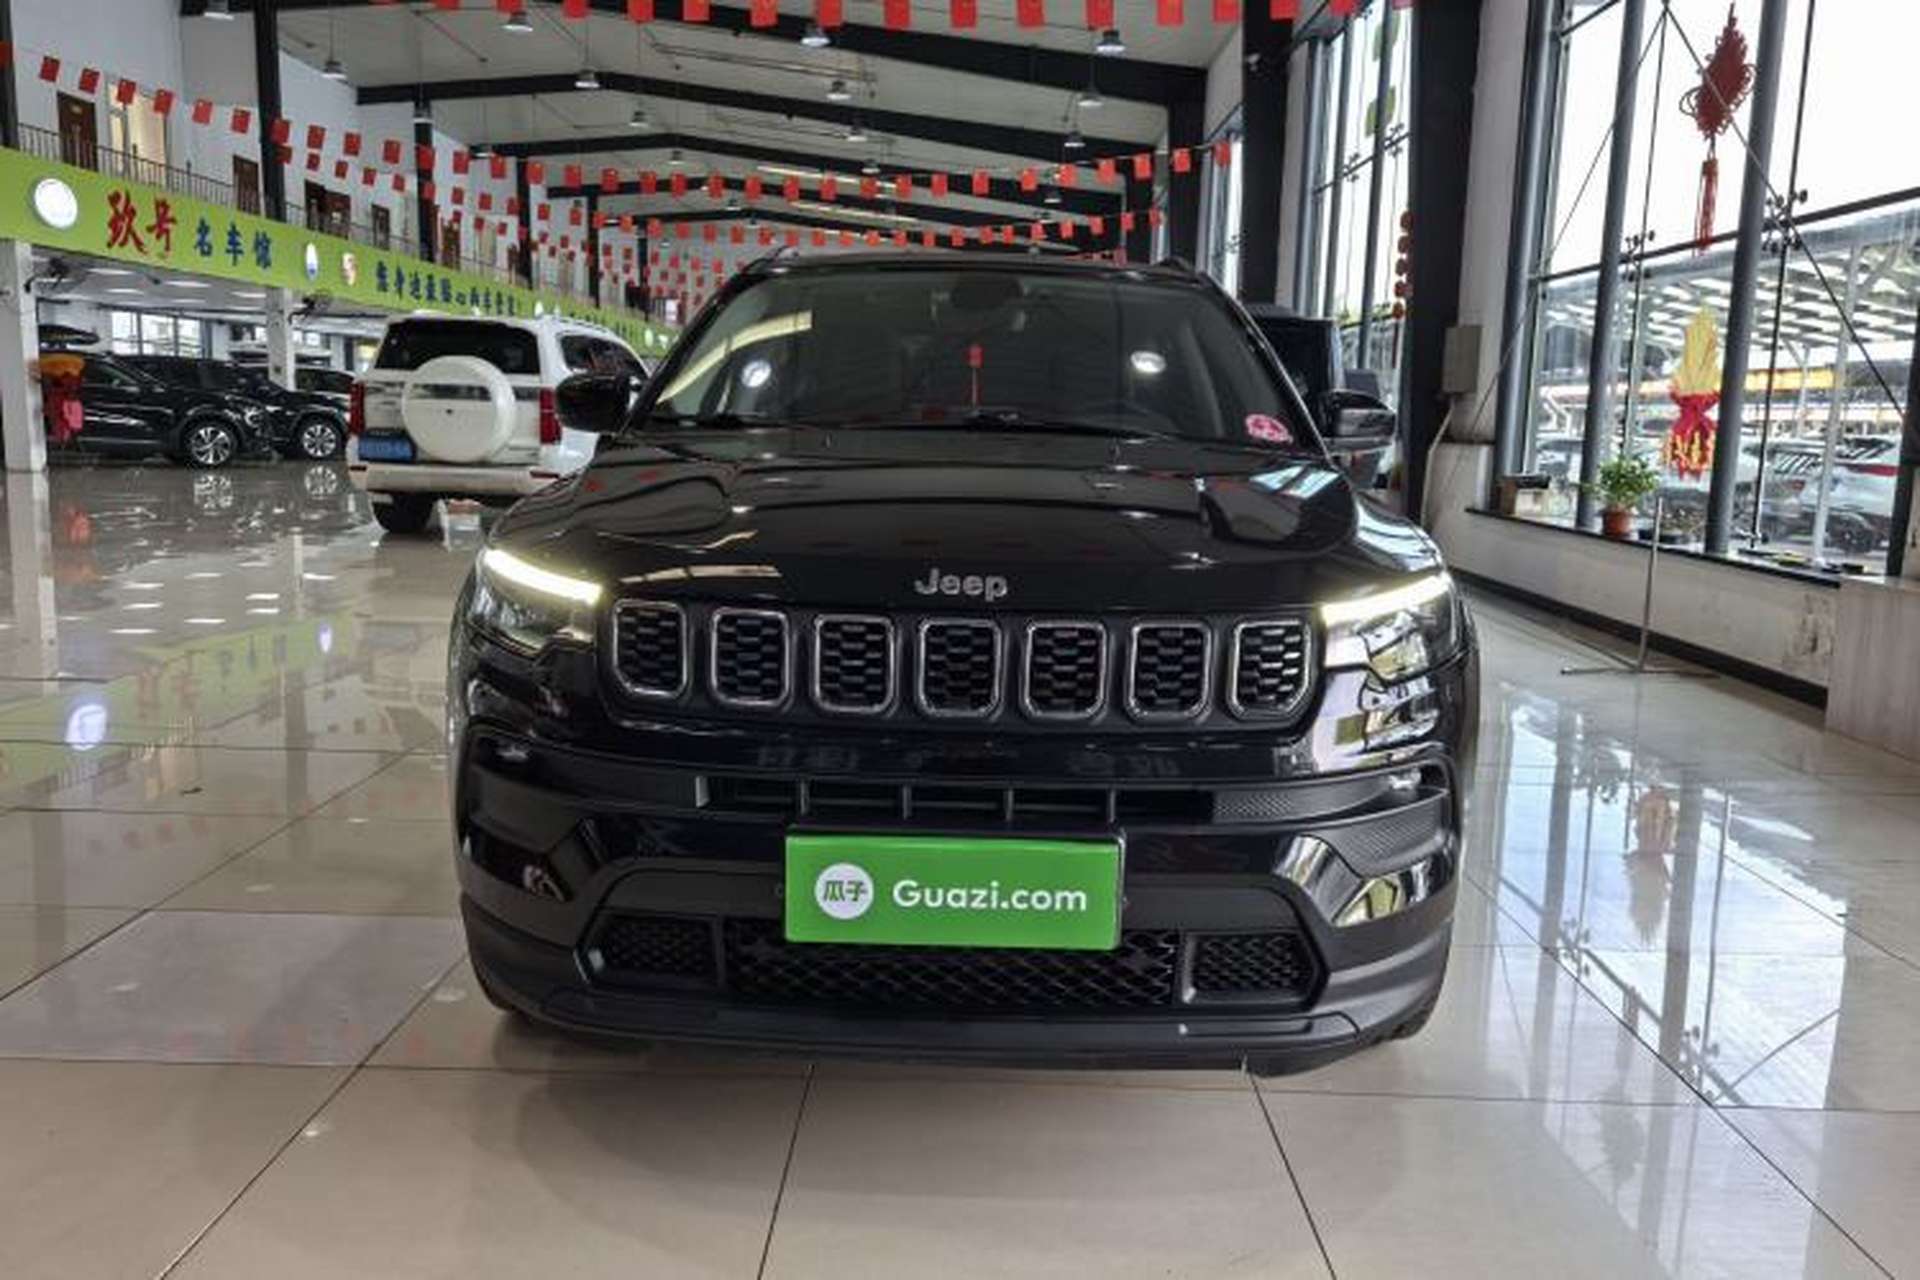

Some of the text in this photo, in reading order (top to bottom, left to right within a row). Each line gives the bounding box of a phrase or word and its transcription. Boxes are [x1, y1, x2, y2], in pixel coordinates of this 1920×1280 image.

[106, 187, 178, 255] 玖号
[914, 567, 1008, 602] Jeep
[823, 879, 868, 902] 瓜子
[892, 879, 1088, 911] Guazi.com
